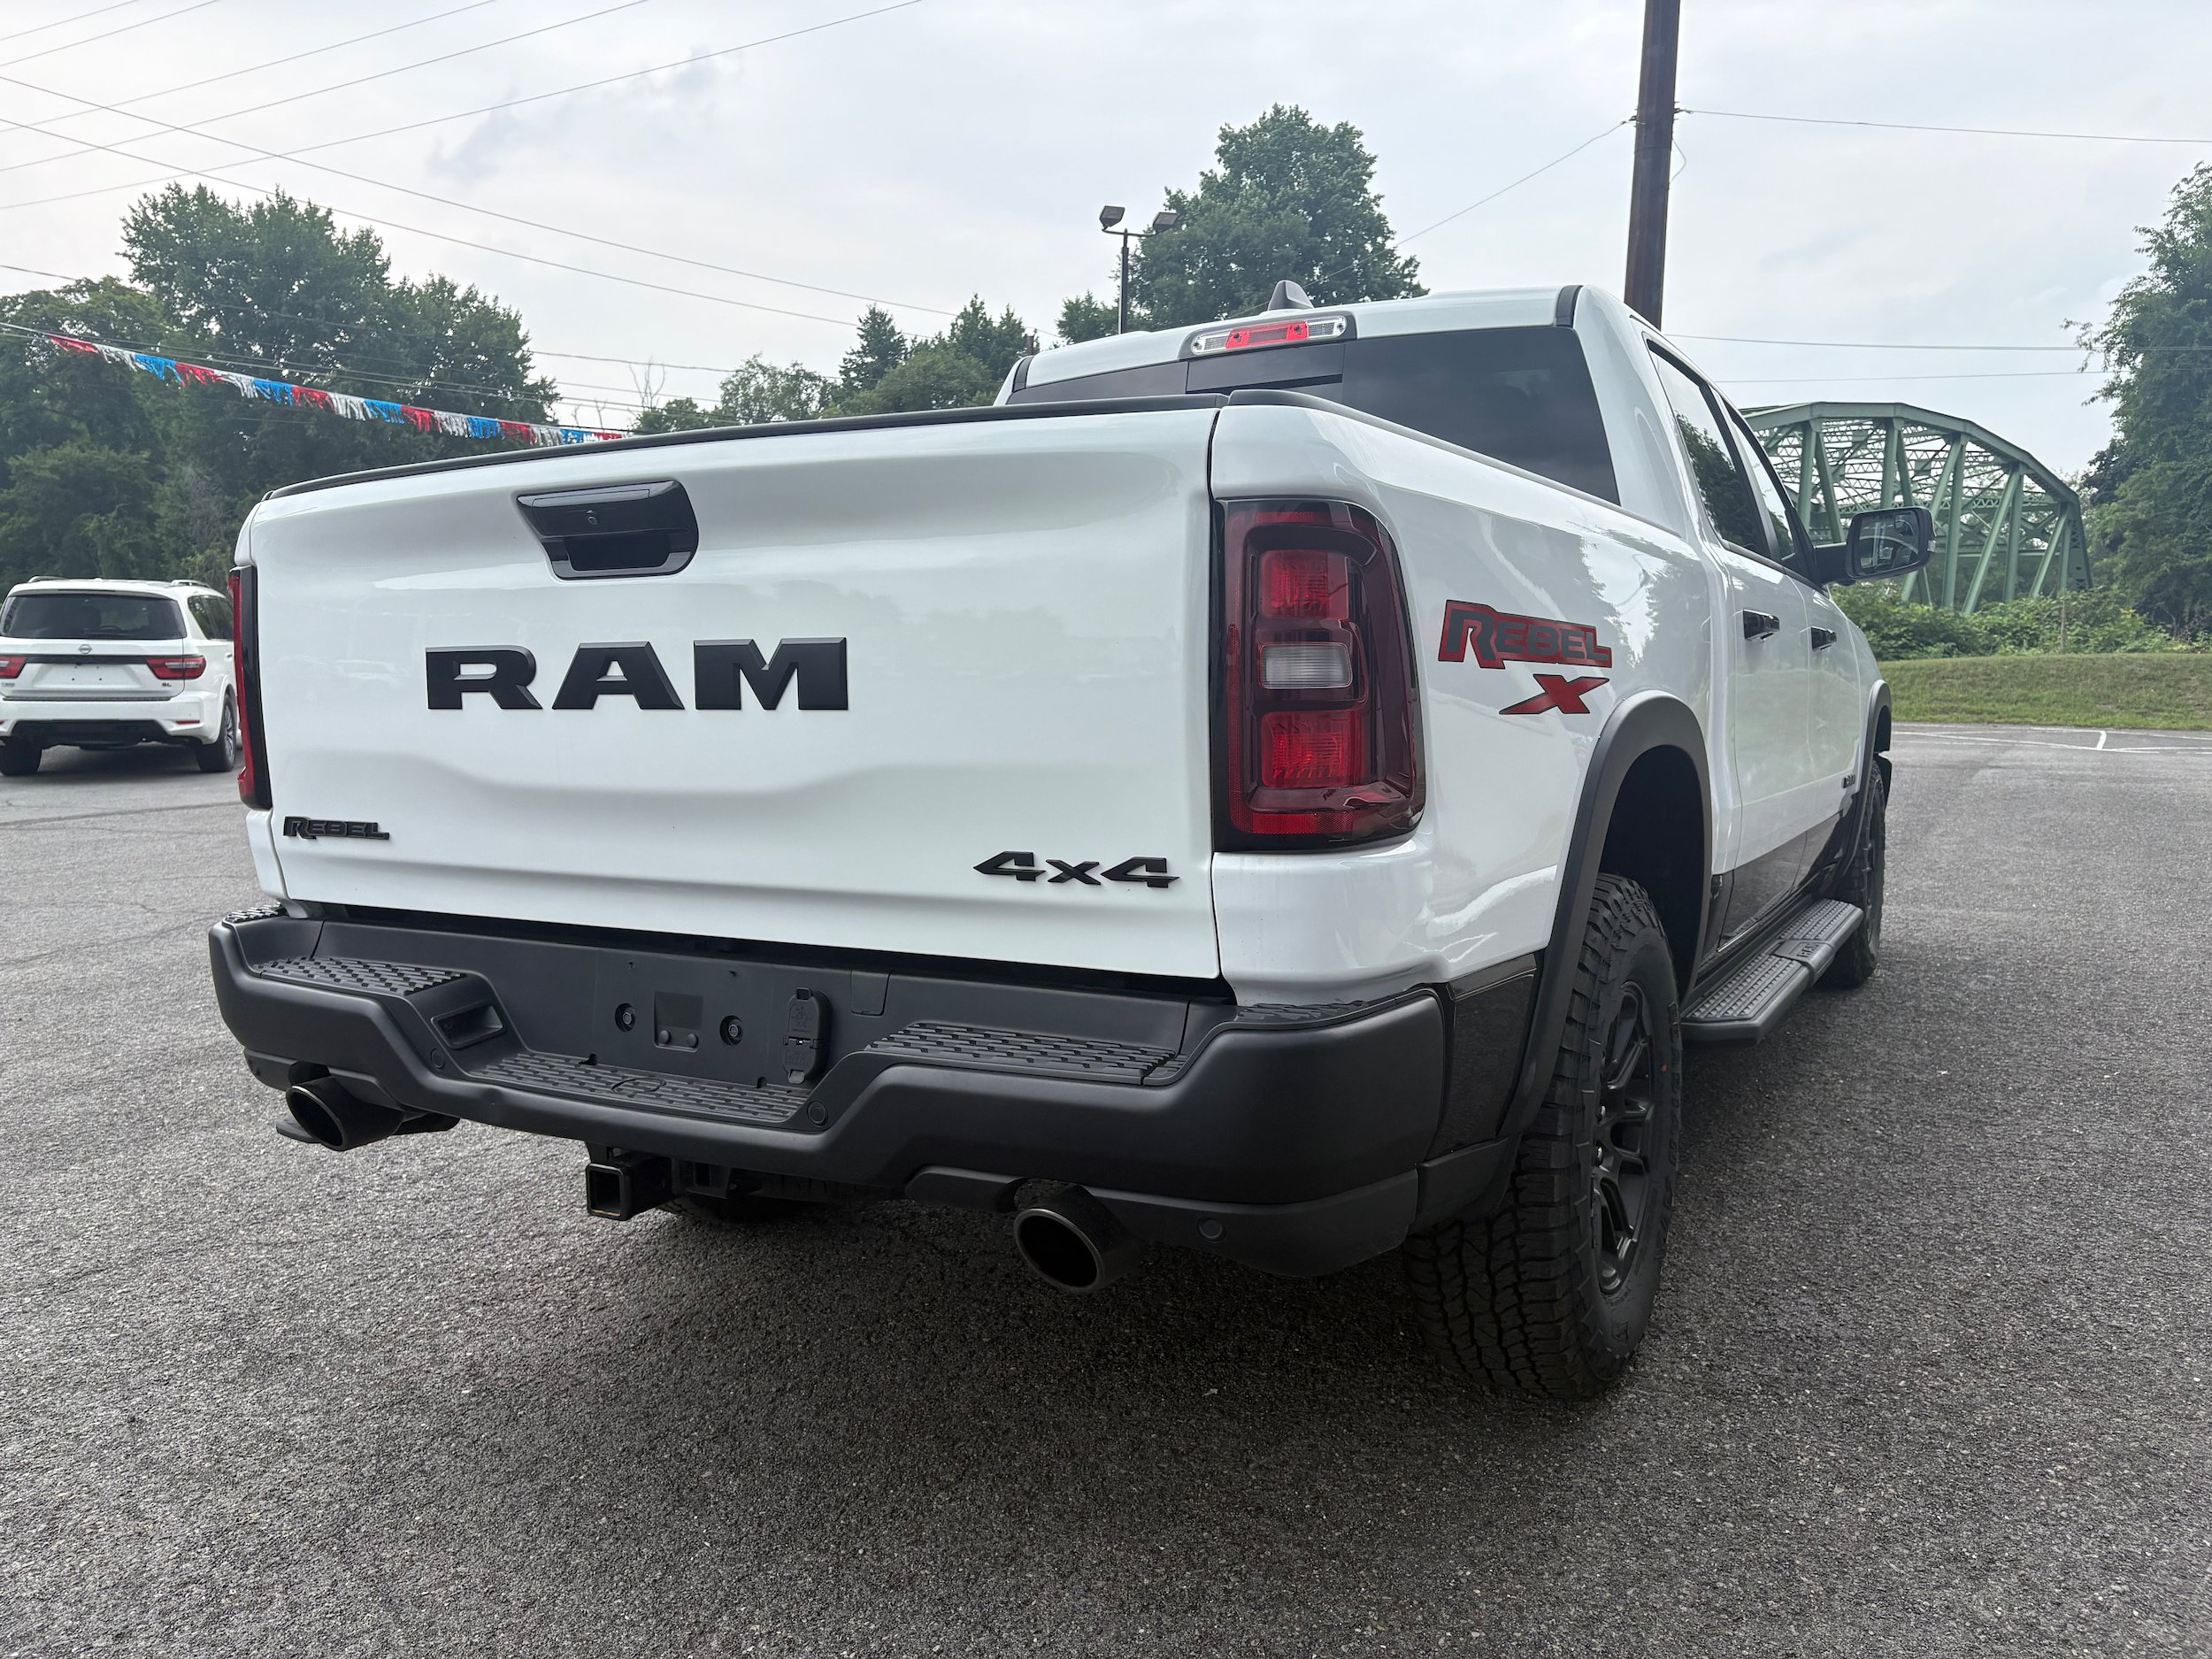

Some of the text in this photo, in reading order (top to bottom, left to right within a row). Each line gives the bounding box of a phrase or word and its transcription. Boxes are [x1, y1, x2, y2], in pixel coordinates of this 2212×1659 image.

[1438, 599, 1612, 670] REBEL
[426, 636, 848, 710] RAM
[1499, 673, 1610, 715] X
[283, 816, 390, 841] REBEL
[972, 850, 1180, 888] 4x4
